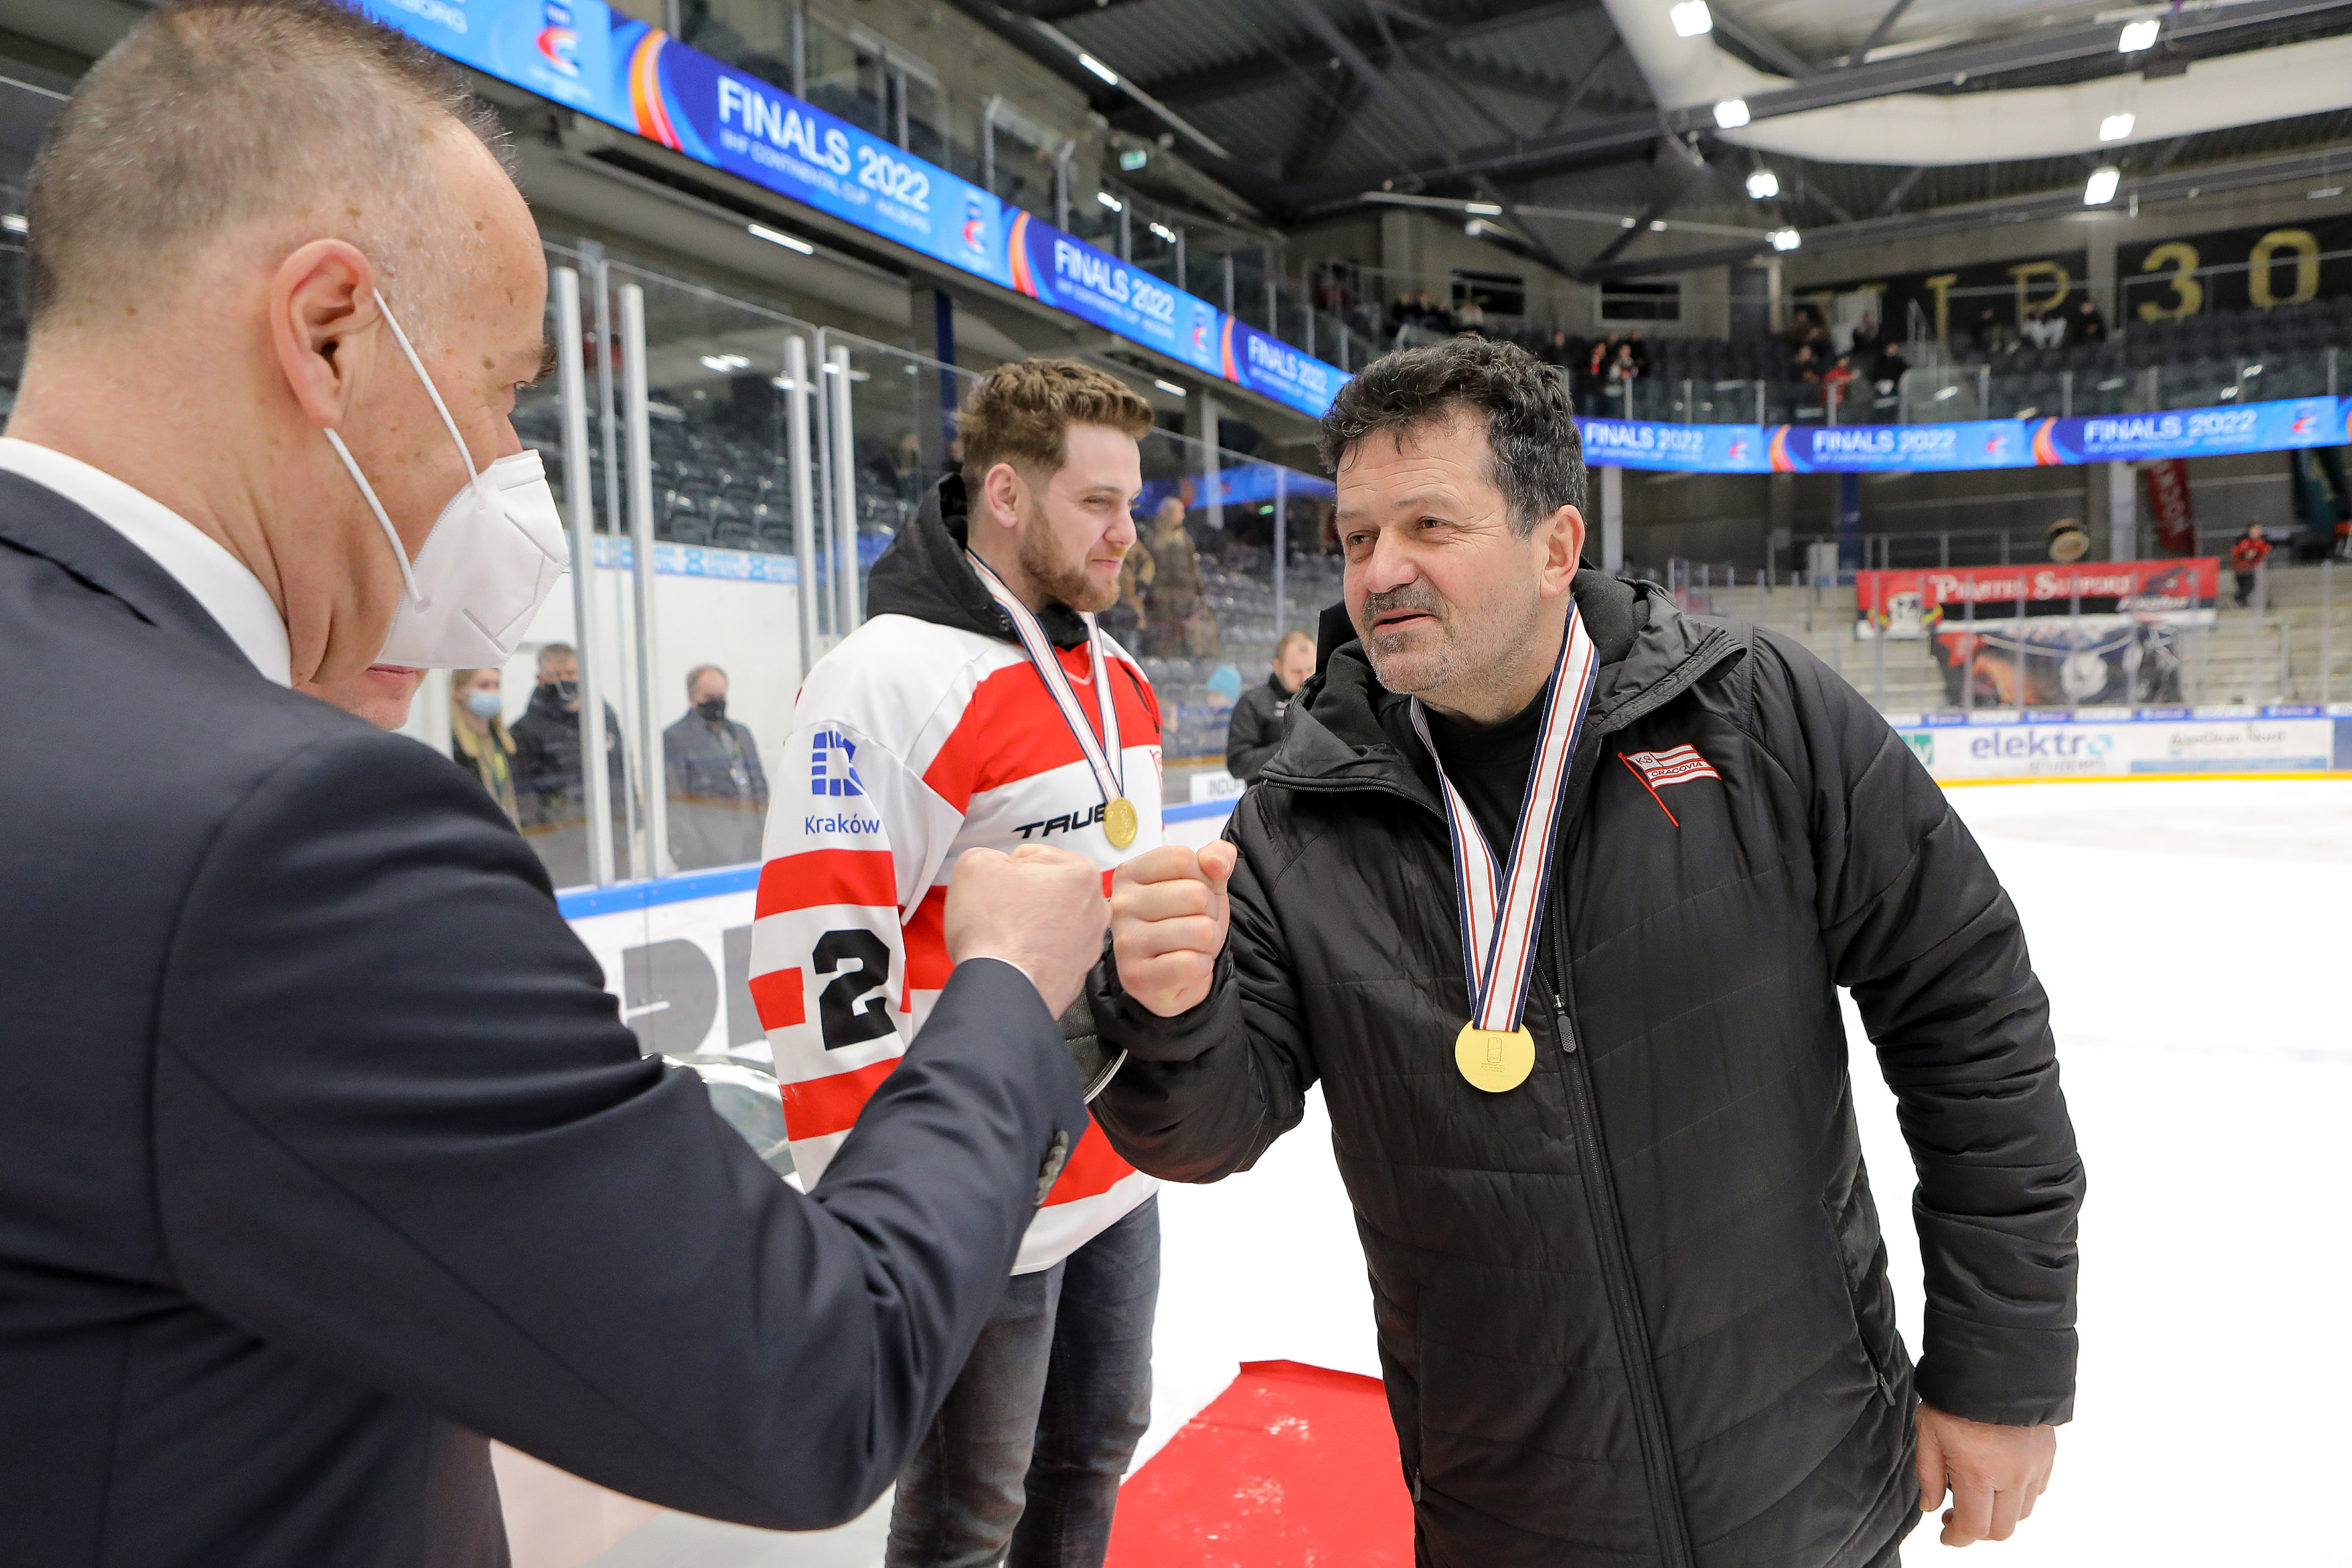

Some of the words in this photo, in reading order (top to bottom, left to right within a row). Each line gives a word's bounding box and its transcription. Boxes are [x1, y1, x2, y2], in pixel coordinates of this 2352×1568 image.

[717, 74, 851, 176] FINALS
[858, 145, 930, 213] 2022
[1054, 238, 1129, 304] FINALS
[1131, 277, 1175, 326] 2022
[1247, 333, 1298, 382] FINALS
[1583, 422, 1655, 449] FINALS
[1657, 428, 1703, 452] 2022
[1812, 430, 1895, 453] FINALS
[1898, 428, 1956, 453] 2022
[2083, 415, 2183, 443] FINALS
[2188, 408, 2257, 437] 2022
[1634, 755, 1654, 765] KS
[1651, 761, 1703, 777] CRACOVIA
[805, 813, 880, 835] Kraków
[1012, 802, 1107, 839] TRUE
[813, 929, 898, 1051] 2
